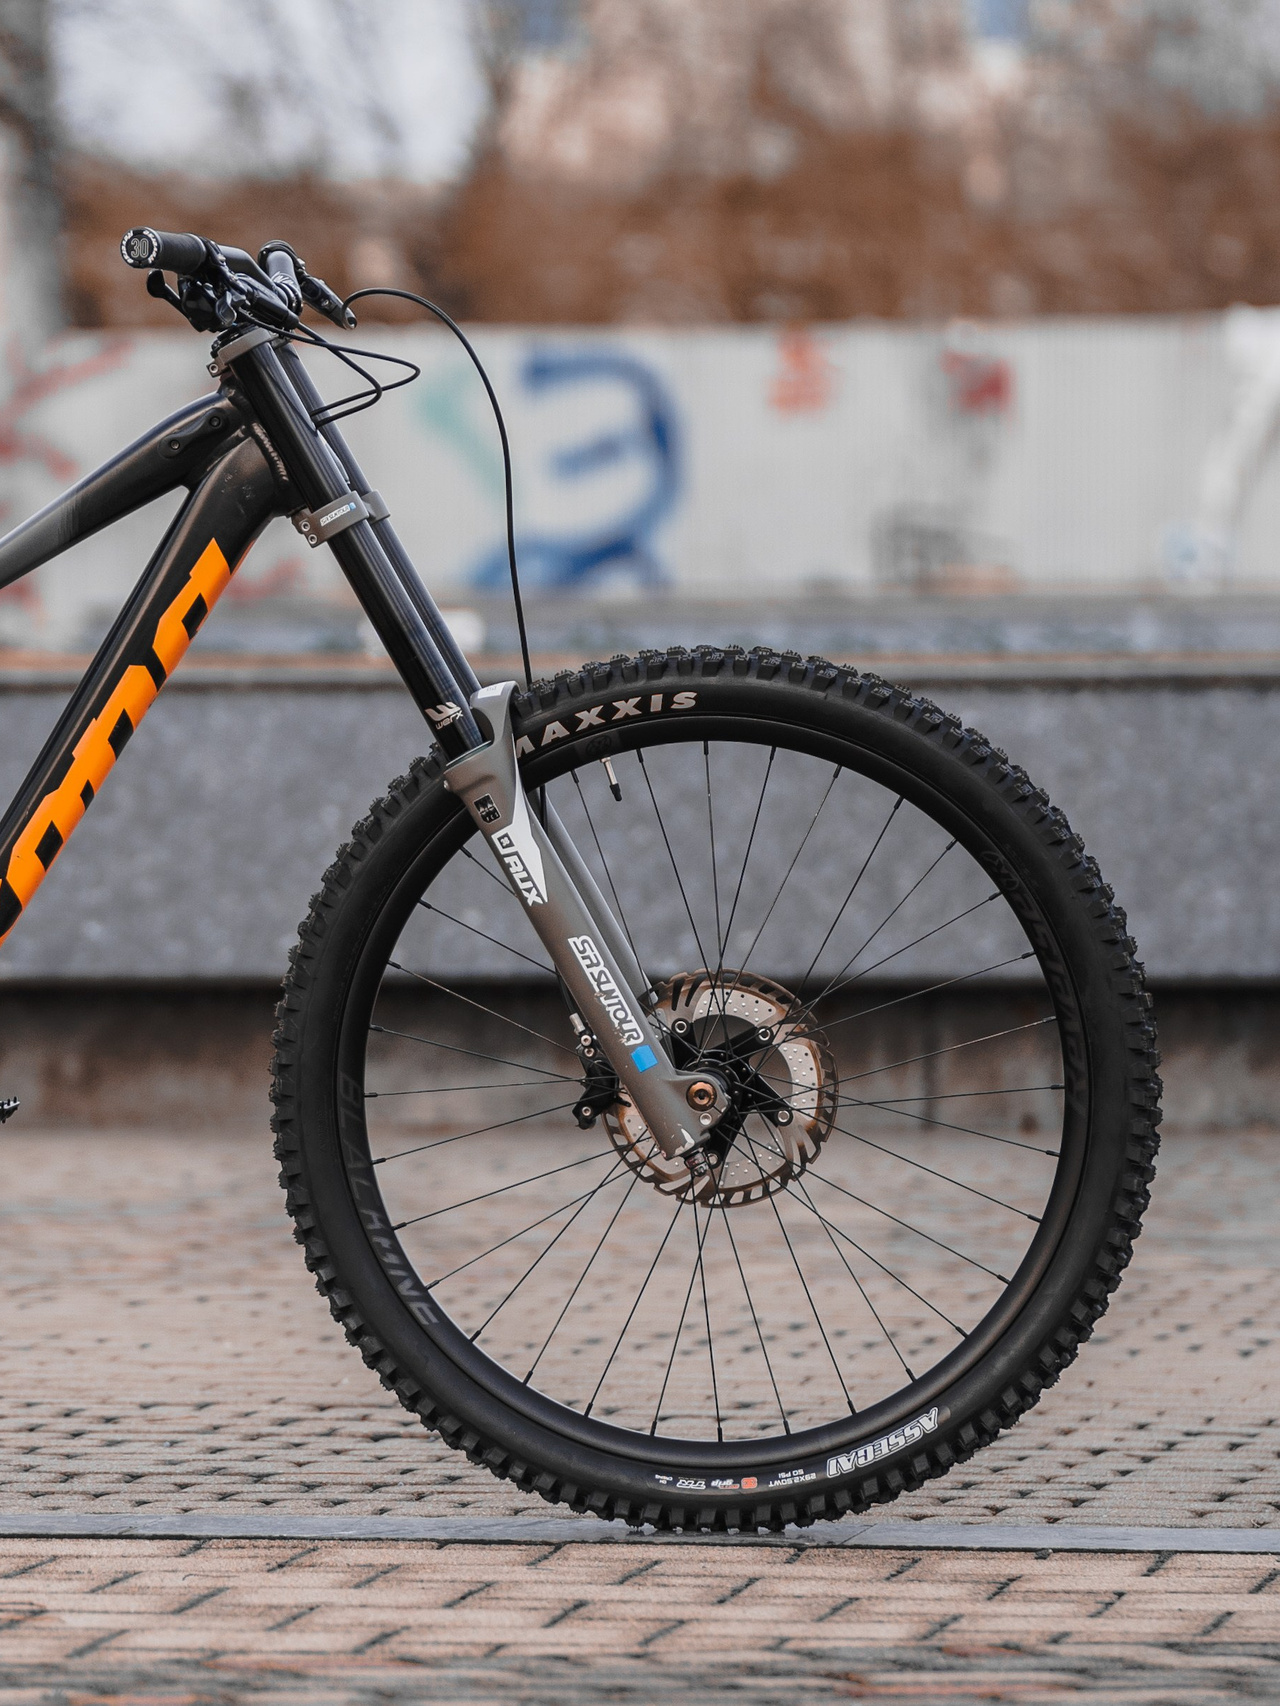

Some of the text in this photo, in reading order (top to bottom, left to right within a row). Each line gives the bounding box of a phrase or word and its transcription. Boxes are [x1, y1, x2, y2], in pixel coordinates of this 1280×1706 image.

[130, 237, 148, 258] 30
[516, 691, 697, 758] MAXXIS
[504, 855, 544, 906] RUX
[827, 1407, 939, 1478] ASSEGAI
[677, 1479, 706, 1490] TR
